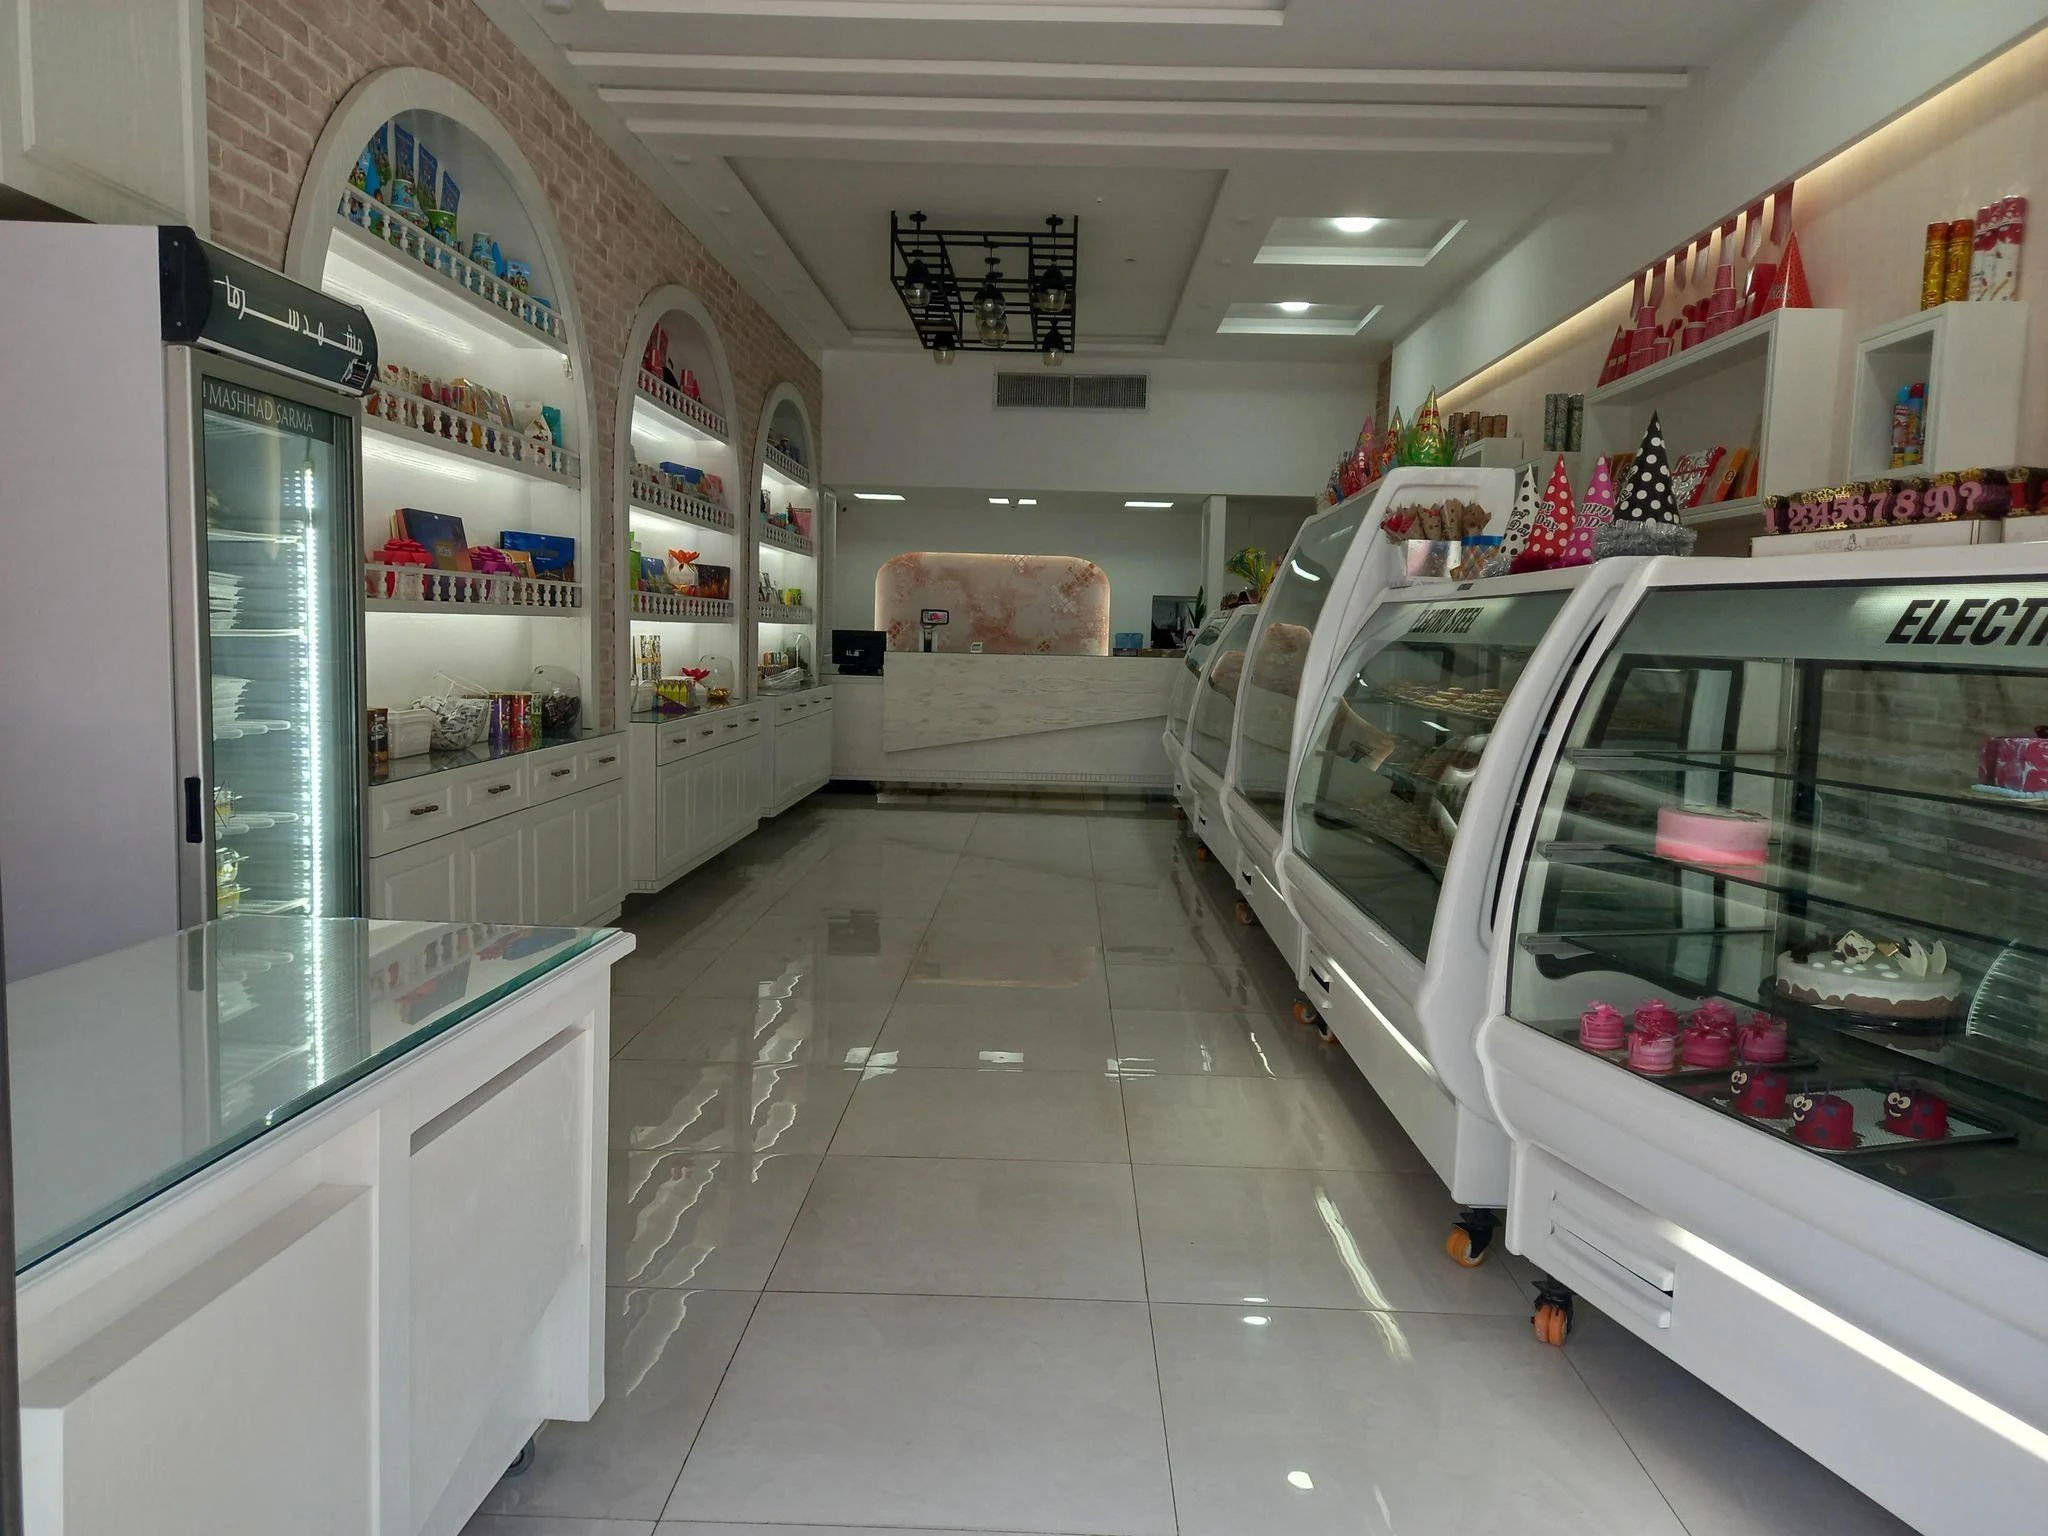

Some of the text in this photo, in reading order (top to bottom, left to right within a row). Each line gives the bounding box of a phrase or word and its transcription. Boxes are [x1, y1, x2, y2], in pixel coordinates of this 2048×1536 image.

[209, 384, 314, 433] MASHHAD SARMA
[1408, 607, 1485, 633] ELECTRO STEEL
